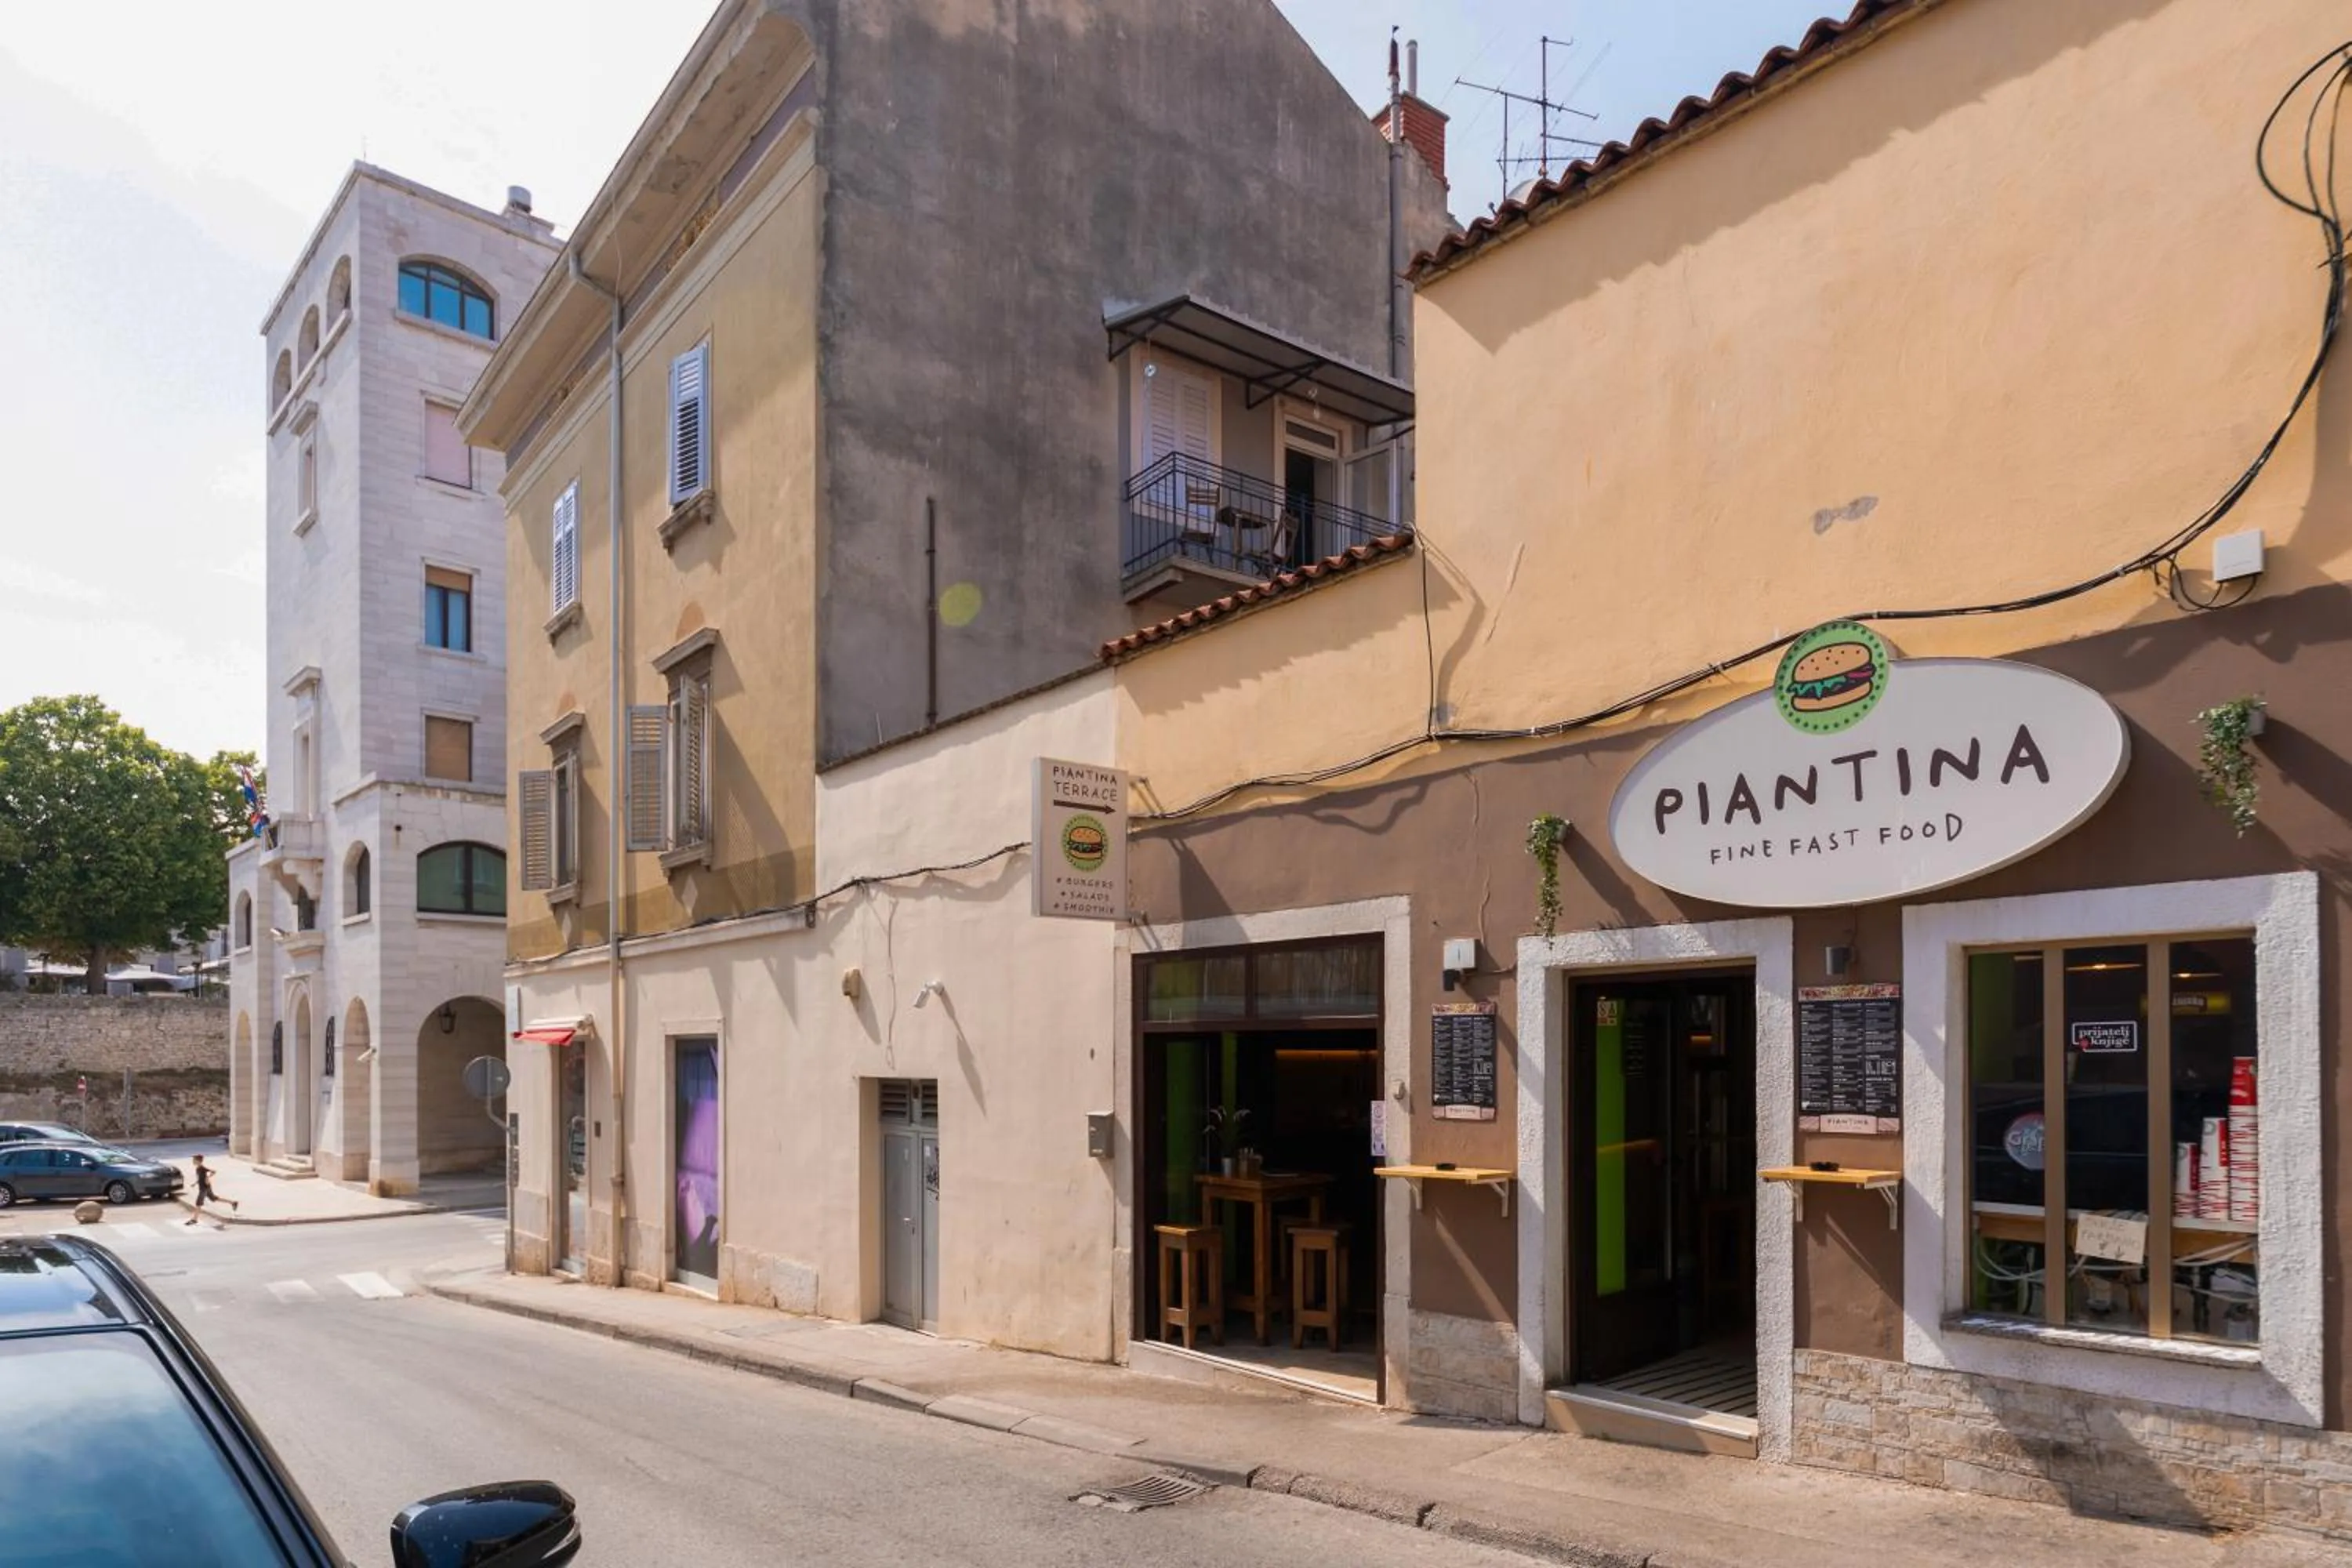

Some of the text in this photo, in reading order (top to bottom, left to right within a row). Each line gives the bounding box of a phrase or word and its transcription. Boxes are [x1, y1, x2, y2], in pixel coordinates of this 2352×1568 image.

[1053, 766, 1117, 785] PIANTINA
[1654, 724, 2051, 834] PIANTINA
[1053, 780, 1117, 801] TERRACE
[1710, 813, 1962, 864] FINE FAST FOOD
[1066, 877, 1113, 890] BURGERS
[1069, 891, 1109, 902] SALADS
[2079, 1025, 2130, 1039] prijatelj
[2091, 1036, 2130, 1048] knjige
